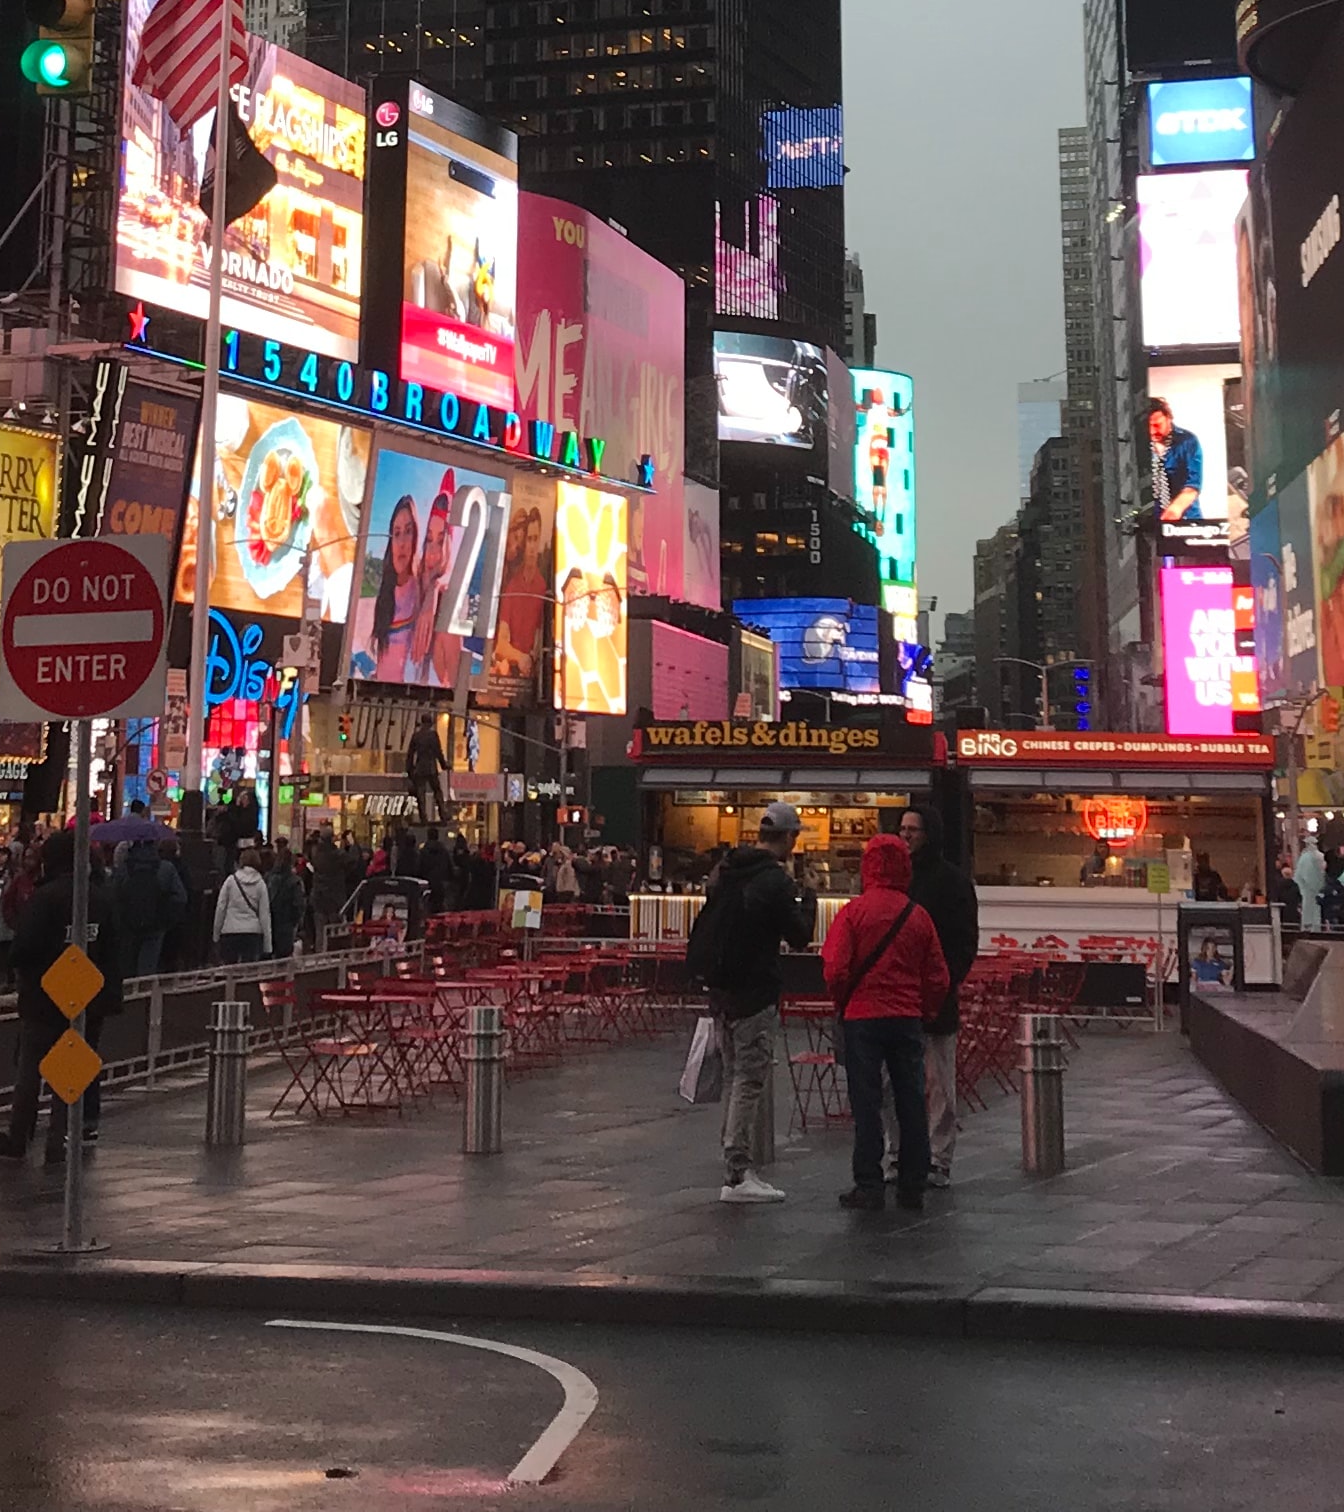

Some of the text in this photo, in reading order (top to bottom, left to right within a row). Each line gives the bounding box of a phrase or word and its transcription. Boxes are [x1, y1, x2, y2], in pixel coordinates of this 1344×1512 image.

[375, 131, 399, 147] LG
[552, 216, 585, 250] YOU
[111, 499, 176, 537] COME
[33, 574, 136, 604] DO NOT
[37, 653, 126, 684] ENTER
[977, 733, 1001, 743] MR
[1022, 740, 1071, 752] CHINESE
[1249, 743, 1270, 755] TEA
